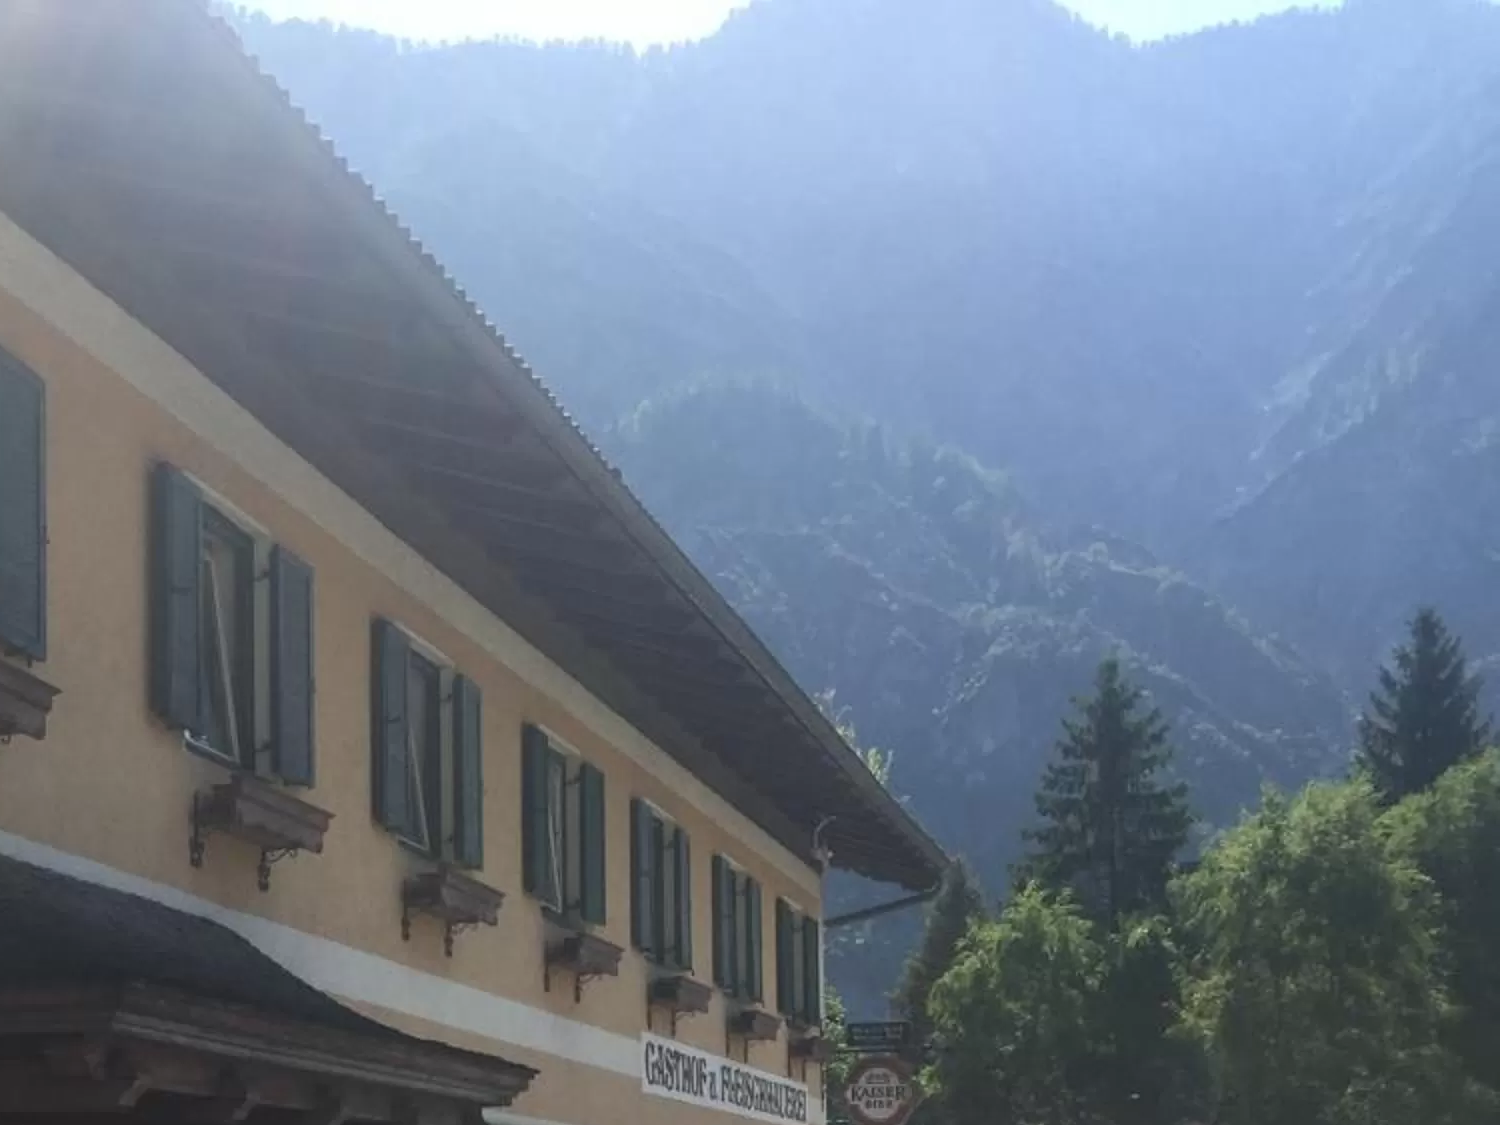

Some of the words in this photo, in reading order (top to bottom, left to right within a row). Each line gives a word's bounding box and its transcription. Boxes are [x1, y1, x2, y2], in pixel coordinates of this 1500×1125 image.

[645, 1039, 707, 1097] GASTHOF
[851, 1085, 905, 1102] KAISER
[865, 1099, 893, 1109] BIER
